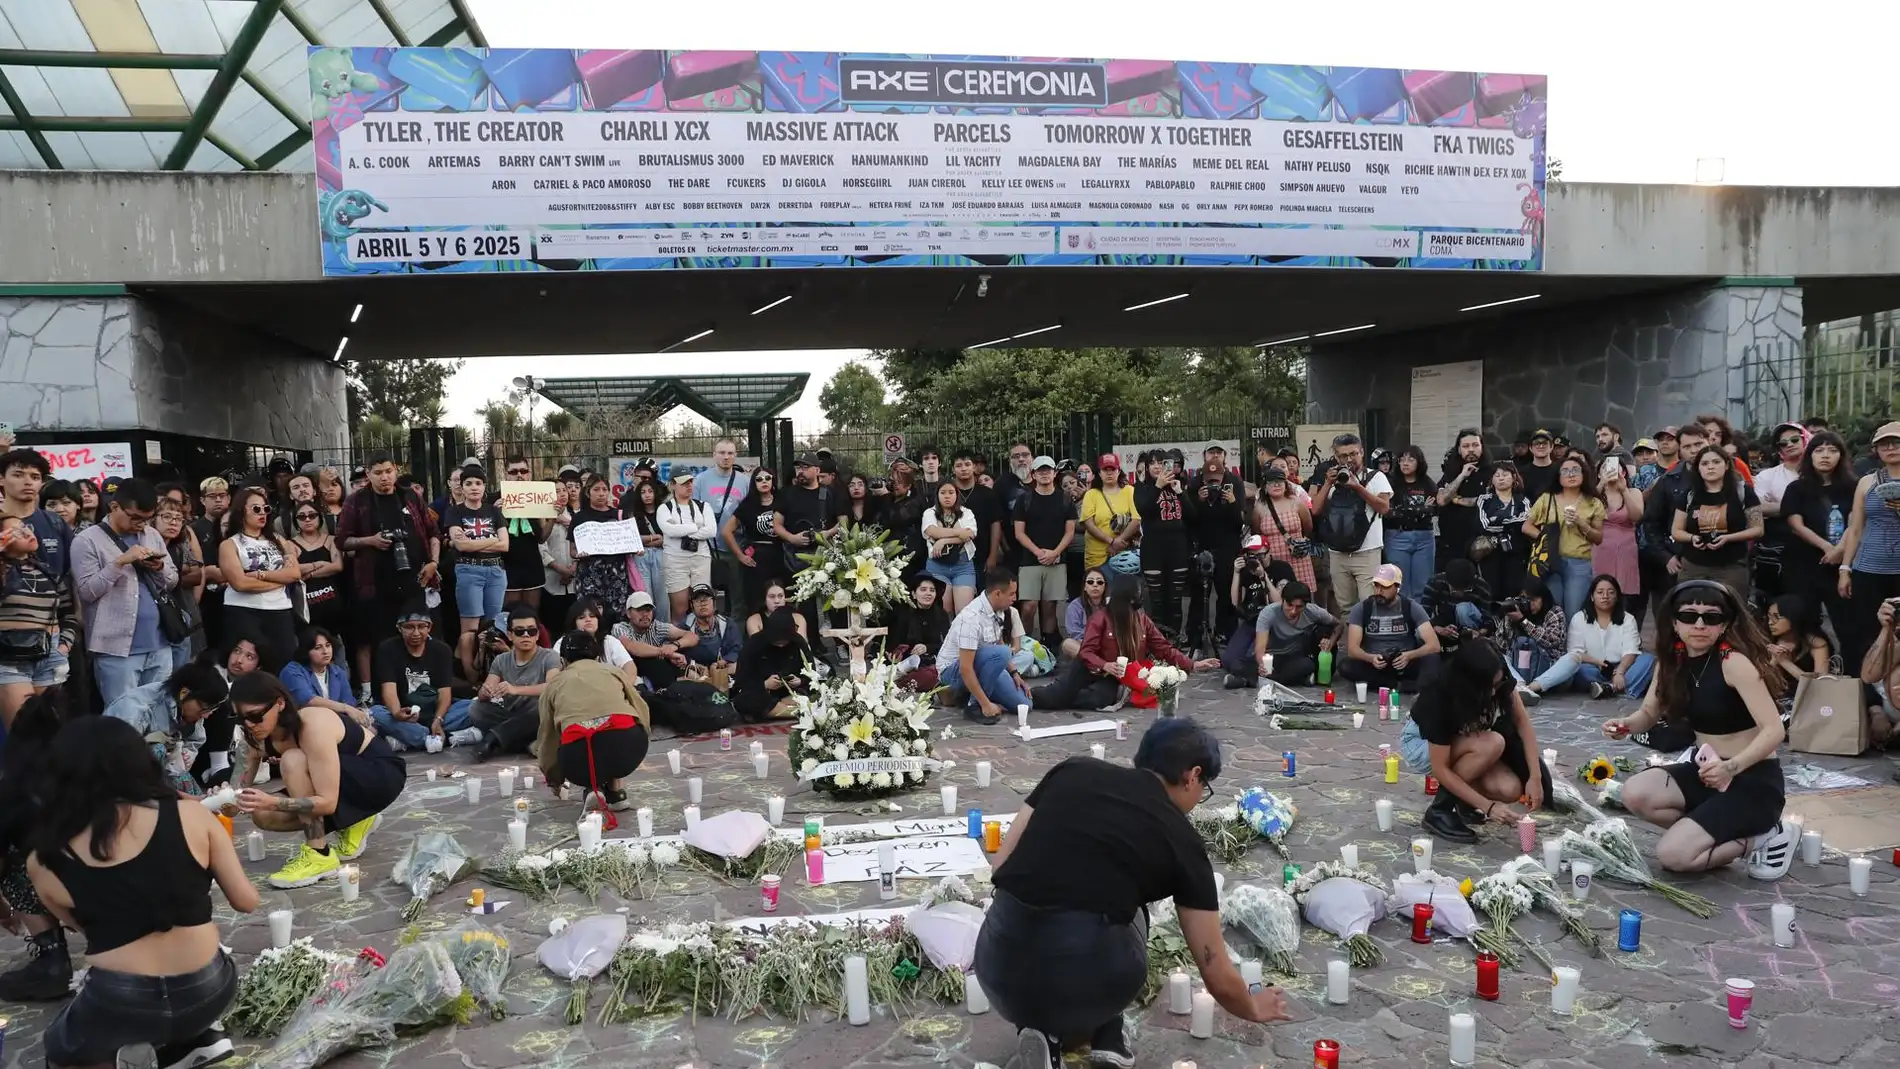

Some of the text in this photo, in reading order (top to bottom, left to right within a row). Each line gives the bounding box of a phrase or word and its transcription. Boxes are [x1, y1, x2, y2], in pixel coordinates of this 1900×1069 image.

[850, 69, 1096, 96] AXE CEREMONIA
[433, 120, 471, 142] THE
[476, 120, 564, 142] CREATOR
[600, 120, 668, 142] CHARLI
[673, 120, 711, 141] XCX
[746, 120, 828, 142] MASSIVE
[832, 121, 899, 142] ATTACK
[933, 122, 1011, 143] PARCELS
[1043, 123, 1145, 145] TOMORROW
[1150, 125, 1162, 145] X
[1165, 125, 1252, 147] TOGETHER
[1282, 128, 1403, 152] GESAFFELSTEIN
[1433, 134, 1463, 154] FKA
[1466, 135, 1516, 157] TWIGS
[348, 156, 360, 169] A.
[363, 156, 375, 170] G.
[378, 155, 410, 169] COOK
[427, 155, 481, 168] ARTEMAS
[498, 154, 535, 168] BARRY
[538, 154, 571, 167] CAN'T
[574, 154, 605, 168] SWIM
[638, 153, 714, 167] BRUTALISMUS
[716, 153, 745, 166] 3000
[761, 154, 776, 166] ED
[779, 153, 834, 166] MAVERICK
[851, 153, 929, 167] HANUMANKIND
[945, 154, 961, 167] LIL
[962, 155, 1001, 167] YACHTY
[1017, 155, 1080, 168] MAGDALENA
[1082, 155, 1102, 168] BAY
[1116, 156, 1136, 168] THE
[1139, 154, 1177, 169] MARÍAS
[1192, 157, 1222, 170] MEME
[1224, 158, 1243, 170] DEL
[1245, 158, 1270, 171] REAL
[1284, 159, 1314, 172] NATHY
[1316, 160, 1351, 173] PELUSO
[1365, 162, 1390, 176] NSQK
[1404, 163, 1435, 176] RICHIE
[1436, 164, 1470, 177] HAWTIN
[1472, 166, 1491, 178] DEX
[1492, 166, 1508, 179] EFX
[1510, 167, 1527, 179] XOX
[491, 179, 516, 190] ARON
[571, 179, 580, 190] &
[581, 178, 605, 189] PACO
[607, 178, 651, 189] AMOROSO
[667, 178, 685, 189] THE
[686, 177, 710, 188] DARE
[726, 177, 766, 188] FCUKERS
[782, 177, 792, 188] DJ
[794, 177, 827, 188] GIGOLA
[907, 177, 929, 188] JUAN
[931, 178, 966, 188] CIREROL
[981, 178, 1006, 189] KELLY
[1007, 178, 1023, 189] LEE
[1024, 178, 1054, 189] OWENS
[1081, 178, 1130, 189] LEGALLYRXX
[1145, 179, 1195, 190] PABLOPABLO
[1209, 180, 1243, 191] RALPHIE
[1244, 181, 1266, 191] CHOO
[1279, 182, 1314, 192] SIMPSON
[1315, 183, 1345, 193] AHUEVO
[1358, 184, 1387, 194] VALGUR
[1400, 185, 1419, 195] YEYO
[357, 236, 520, 258] ABRIL 5 Y 6 2025
[1430, 235, 1525, 247] PARQUE BICENTENARIO
[658, 246, 685, 254] BOLETOS
[707, 245, 794, 253] ticketmaster.com.mx
[1430, 245, 1453, 255] CDMX
[1251, 428, 1290, 439] ENTRADA
[615, 441, 650, 453] SALIDA
[825, 761, 865, 775] GREMIO
